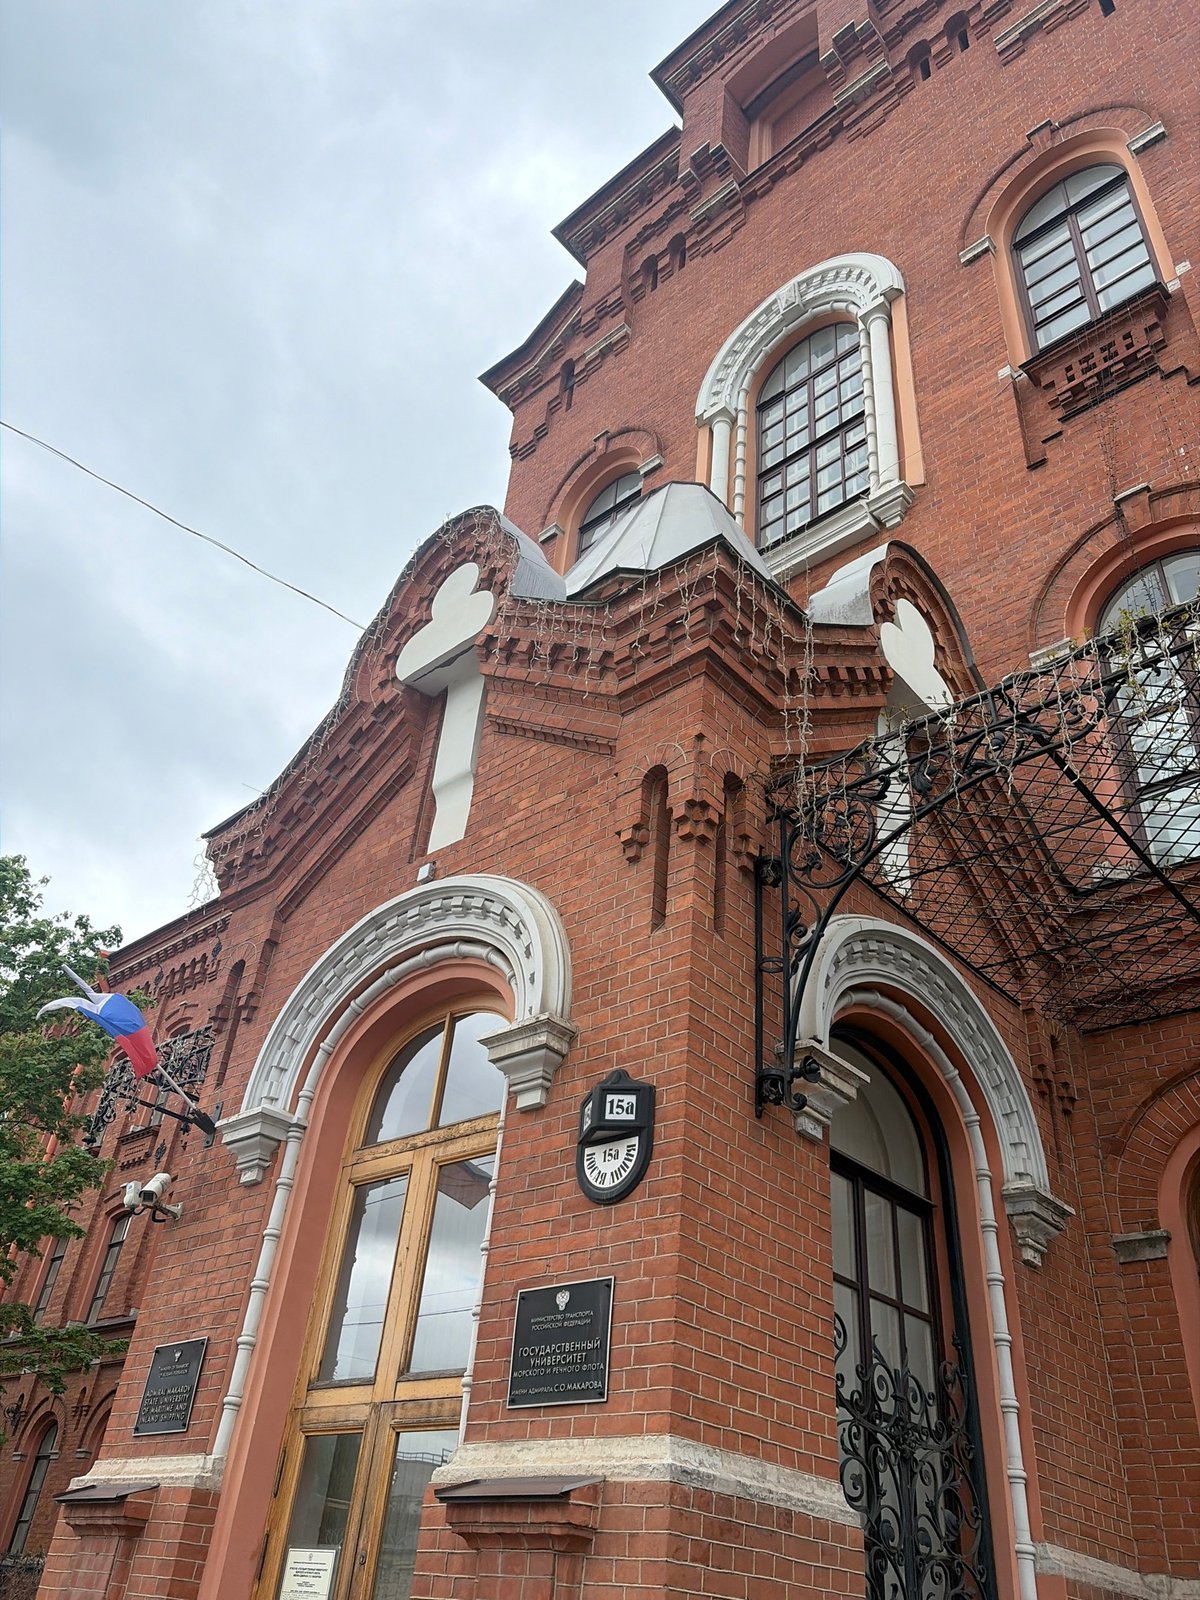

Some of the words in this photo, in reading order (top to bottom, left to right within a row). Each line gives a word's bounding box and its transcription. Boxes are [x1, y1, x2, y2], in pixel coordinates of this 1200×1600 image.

[586, 1152, 607, 1185] КОСАЯ
[609, 1144, 636, 1185] ЛИНИЯ
[531, 1314, 564, 1322] МИНИСТЕРСТВО
[566, 1310, 594, 1319] ТРАНСПОРТА
[532, 1321, 562, 1331] РОССИЙСКОЙ
[564, 1319, 591, 1327] ФЕДЕРАЦИИ
[518, 1337, 601, 1357] ГОСУДАРСТВЕННЫЙ
[530, 1352, 586, 1367] УНИВЕРСИТЕТ
[513, 1368, 545, 1378] МОРСКОГО
[552, 1365, 580, 1374] РЕЧНОГО
[582, 1363, 604, 1371] ФЛОТА
[529, 1386, 553, 1394] АДМИРАЛА
[144, 1397, 159, 1406] STATE
[160, 1393, 190, 1405] UNIVERSITY
[142, 1406, 149, 1414] OF
[175, 1403, 187, 1411] AND
[160, 1412, 185, 1422] SHIPPING
